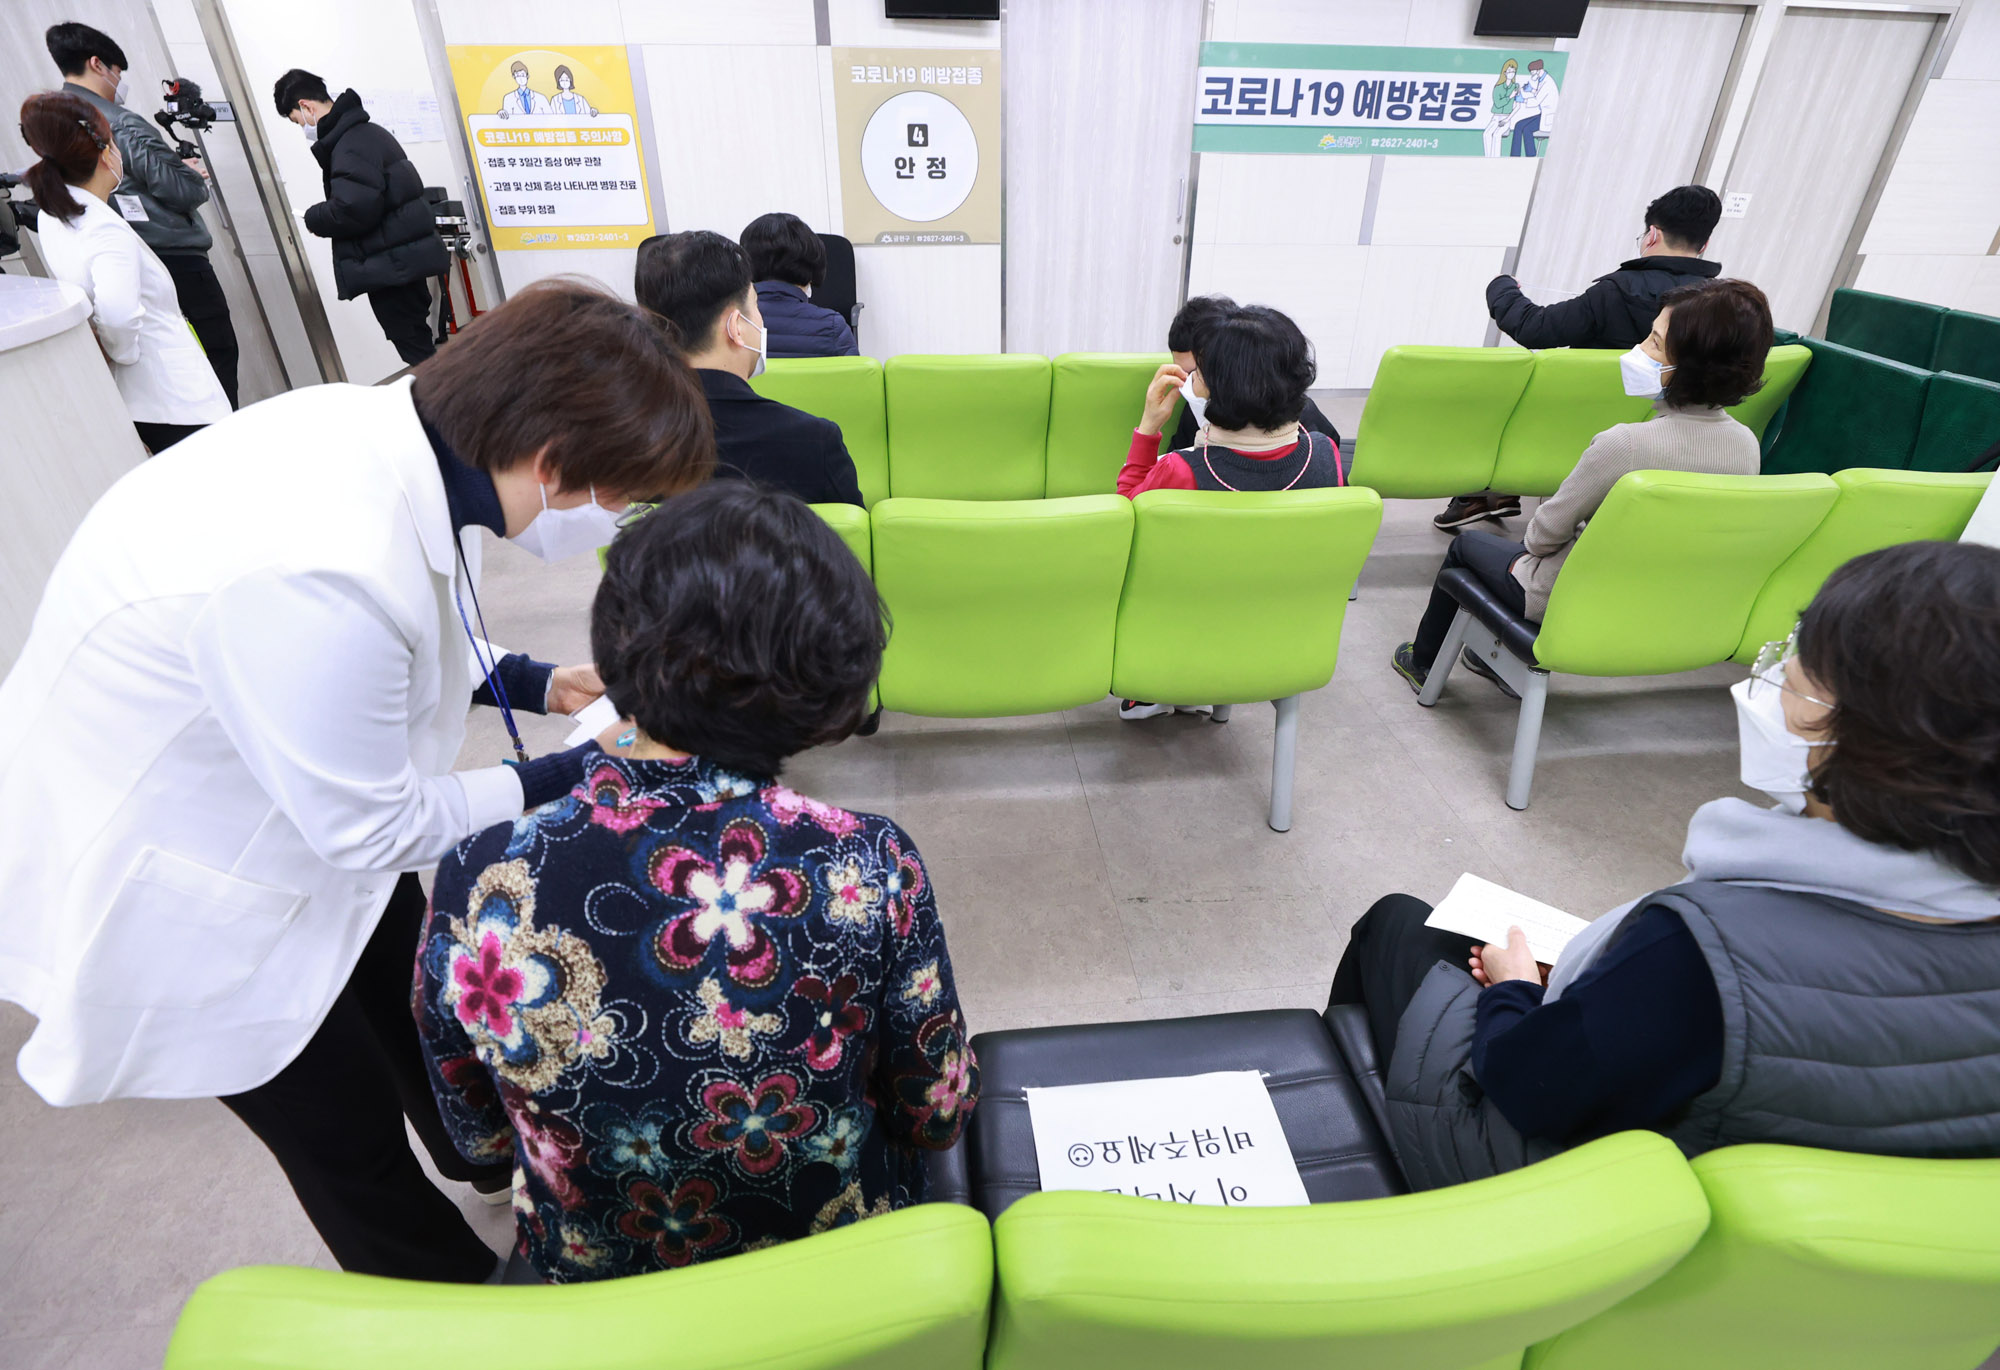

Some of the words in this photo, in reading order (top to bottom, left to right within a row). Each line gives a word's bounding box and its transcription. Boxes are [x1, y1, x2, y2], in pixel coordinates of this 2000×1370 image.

[851, 65, 916, 84] 코로나19
[920, 66, 982, 85] 예방접종
[1201, 77, 1344, 117] 코로나19
[1353, 80, 1482, 122] 예방접종
[484, 131, 531, 144] 코로나19
[533, 130, 577, 144] 예방접종
[580, 130, 623, 143] 주의사항
[913, 126, 924, 145] 4
[1380, 138, 1438, 149] 2627-2401~3
[488, 157, 506, 168] 접종
[507, 157, 517, 168] 후
[519, 157, 542, 168] 3일간
[544, 157, 562, 167] 증상
[564, 157, 582, 167] 여부
[584, 157, 602, 167] 관찰
[493, 181, 511, 192] 고열
[512, 181, 522, 192] 및
[524, 181, 542, 191] 신체
[544, 181, 562, 191] 증상
[563, 181, 598, 191] 나타나면
[599, 181, 618, 190] 병원
[619, 180, 637, 190] 진료
[499, 205, 517, 216] 접종
[518, 205, 536, 215] 부위
[537, 205, 556, 215] 청결
[1094, 1126, 1255, 1164] 비워주세요
